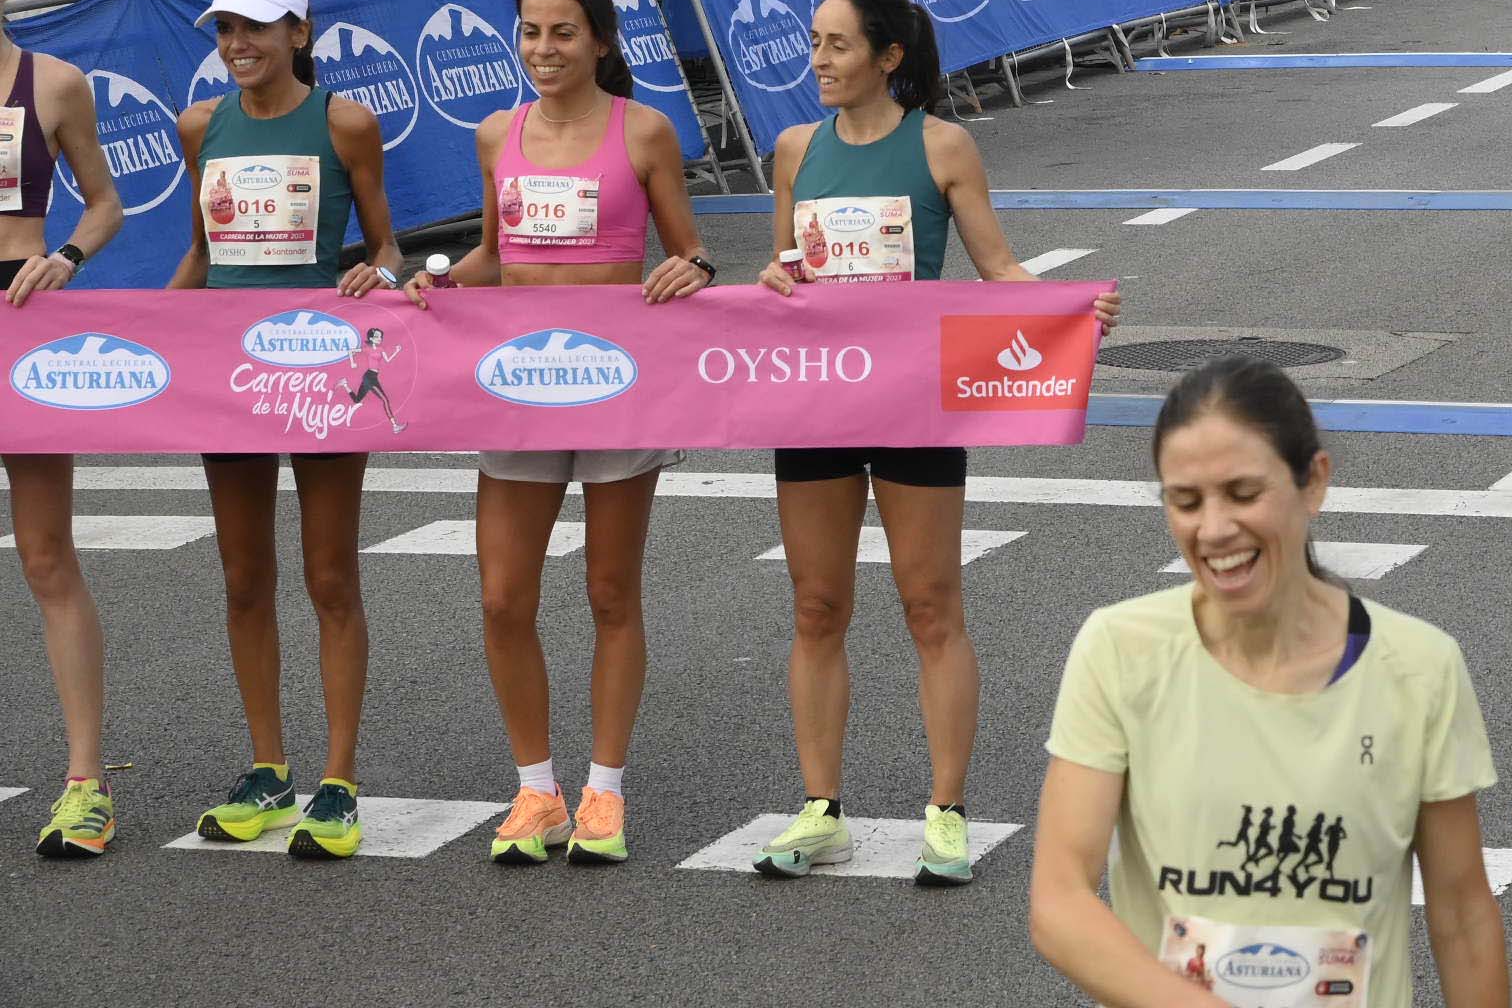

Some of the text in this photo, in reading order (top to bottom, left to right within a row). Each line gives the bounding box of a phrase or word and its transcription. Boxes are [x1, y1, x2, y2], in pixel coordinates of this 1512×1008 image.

[624, 16, 658, 31] CENTRAL
[436, 42, 502, 62] CENTRAL LECHERA
[324, 60, 398, 84] CENTRAL LECHERA
[428, 54, 518, 103] ASTURIANA
[119, 110, 160, 130] LECHERA
[236, 174, 278, 185] ASTURIANA
[527, 178, 570, 188] ASTURIANA
[238, 198, 276, 214] 016
[527, 203, 566, 218] 016
[254, 220, 260, 228] 5
[533, 224, 557, 232] 5540
[829, 217, 872, 226] ASTURIANA
[218, 248, 246, 256] OYSHO
[832, 242, 870, 257] 016
[849, 262, 854, 272] 6
[270, 328, 305, 336] CENTRAL
[250, 330, 351, 353] ASTURIANA
[48, 358, 154, 368] CENTRAL LECHERA
[512, 355, 620, 364] CENTRAL LECHERA
[698, 345, 872, 384] OYSHO
[24, 361, 158, 390] ASTURIANA
[230, 363, 328, 394] Carrera
[489, 358, 624, 387] ASTURIANA
[956, 374, 1076, 398] Santander
[252, 386, 364, 440] de la Mujer
[1158, 866, 1373, 904] RUN4YOU
[1224, 960, 1301, 978] ASTURIANA
